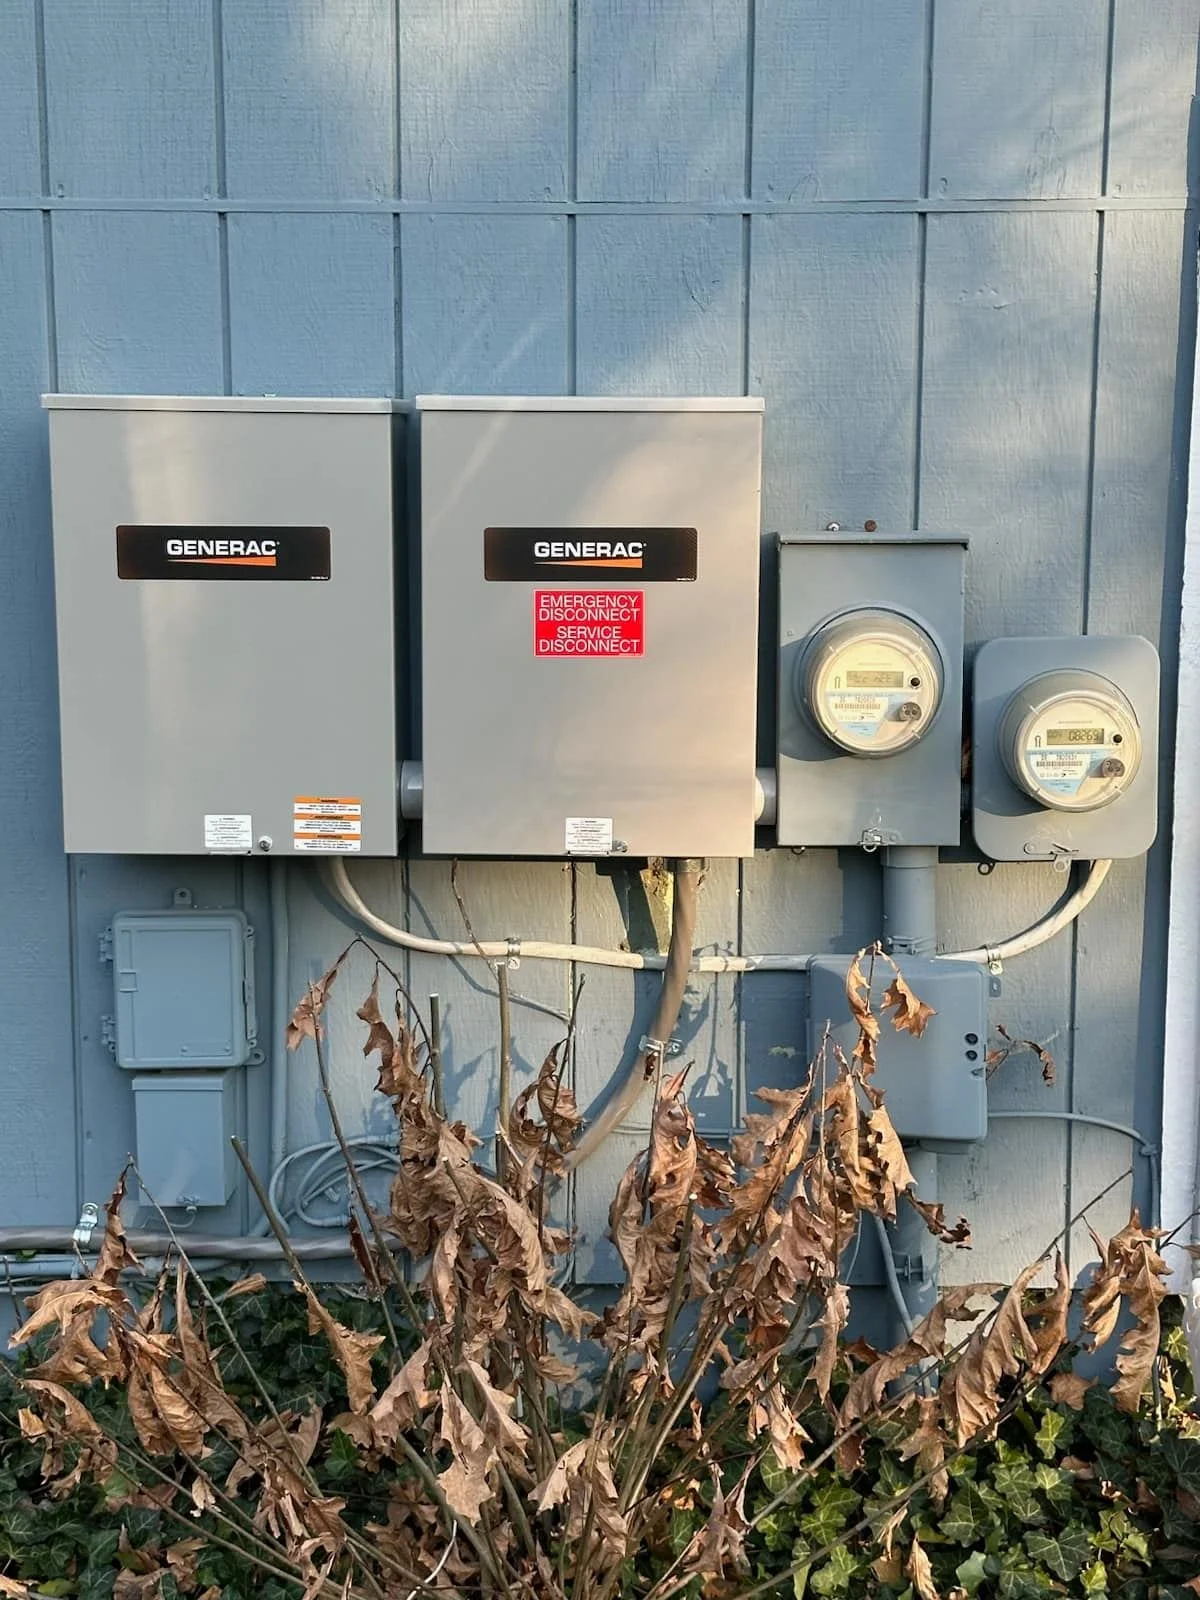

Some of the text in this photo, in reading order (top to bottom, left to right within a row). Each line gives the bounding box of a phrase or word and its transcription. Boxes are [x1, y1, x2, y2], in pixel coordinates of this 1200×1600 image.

[166, 539, 277, 556] GENERAC
[533, 541, 644, 558] GENERAC
[540, 594, 638, 608] EMERGENCY
[539, 608, 640, 622] DISCONNECT
[556, 625, 622, 639] SERVICE
[539, 639, 640, 653] DISCONNECT
